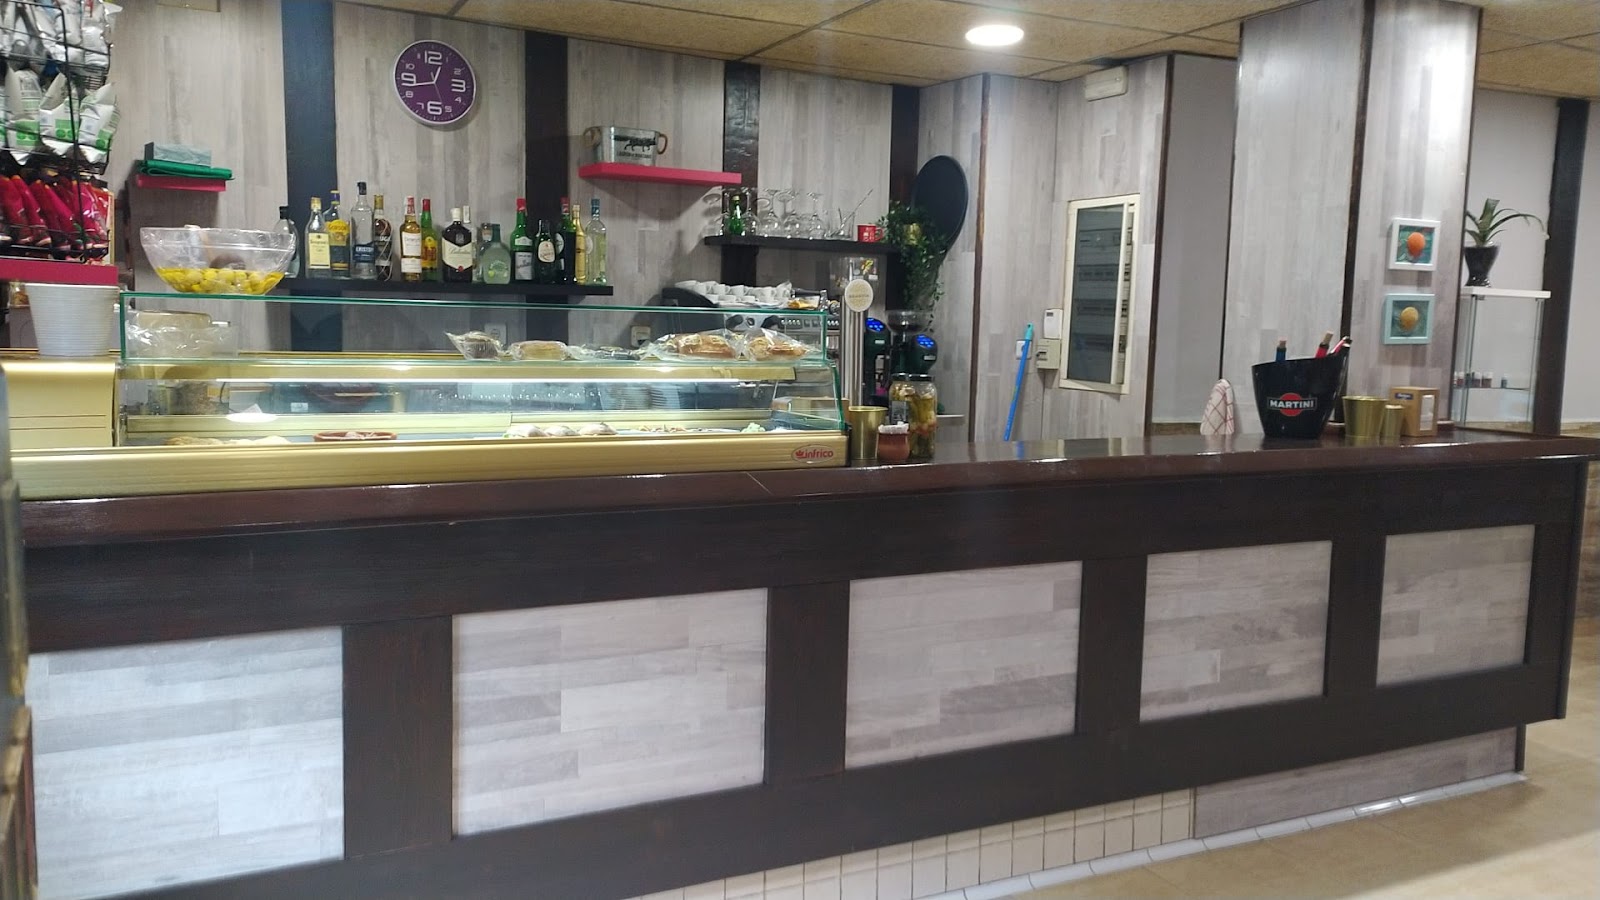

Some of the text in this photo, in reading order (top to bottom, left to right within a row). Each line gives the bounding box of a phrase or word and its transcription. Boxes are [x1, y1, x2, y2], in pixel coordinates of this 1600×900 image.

[424, 50, 443, 65] 12
[405, 62, 415, 70] 10
[453, 68, 462, 76] 2
[401, 72, 416, 87] 9
[451, 79, 466, 92] 3
[405, 90, 414, 98] 8
[427, 101, 442, 115] 6
[444, 105, 452, 113] 5
[1269, 400, 1314, 409] MARTINI
[805, 448, 834, 459] infrico
